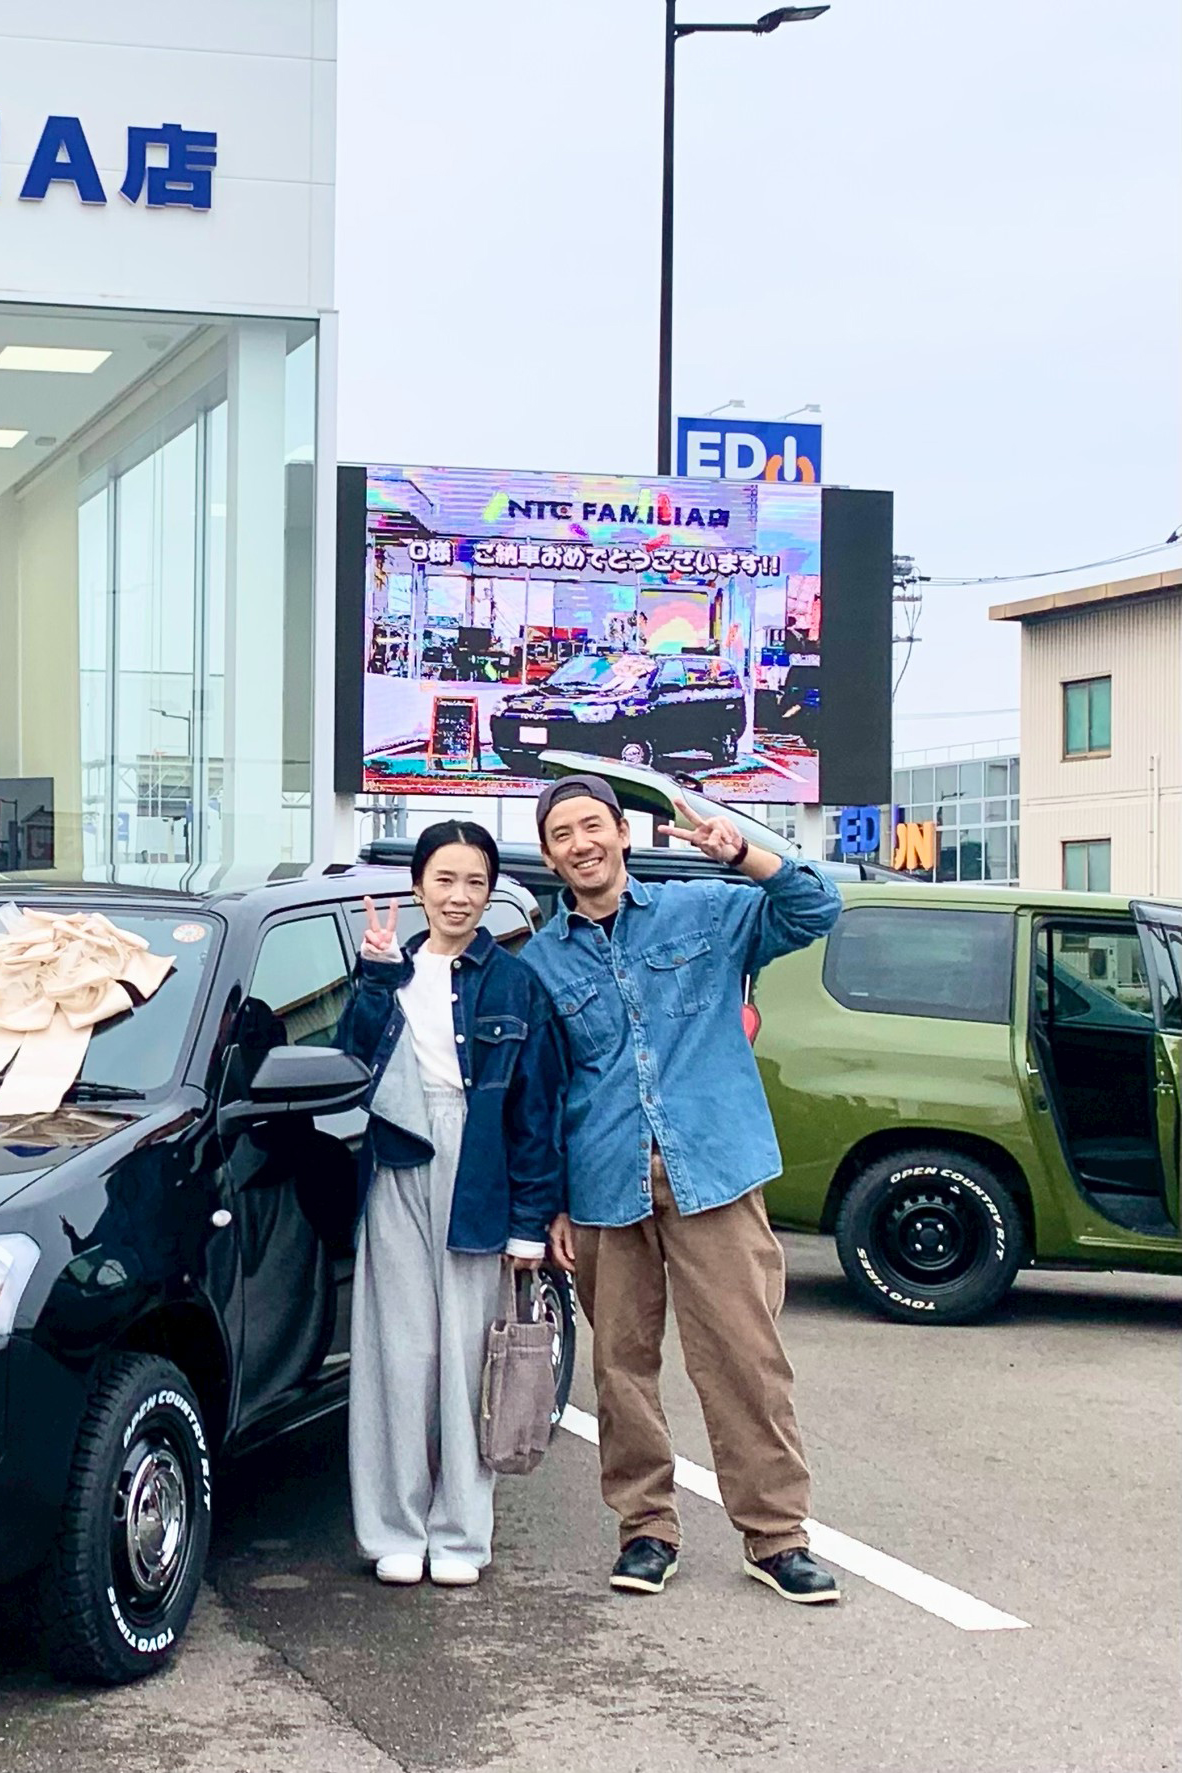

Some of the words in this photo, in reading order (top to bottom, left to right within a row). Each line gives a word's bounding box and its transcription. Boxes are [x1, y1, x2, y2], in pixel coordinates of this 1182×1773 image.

[890, 1166, 938, 1184] OPEN
[940, 1168, 1003, 1225] COUNTRY
[995, 1226, 1006, 1261] R/T
[856, 1246, 890, 1294] TIRES
[888, 1291, 936, 1311] TOYO
[123, 1394, 157, 1449] OPEN
[158, 1389, 207, 1451] COUNTRY
[137, 1626, 175, 1653] TOYO
